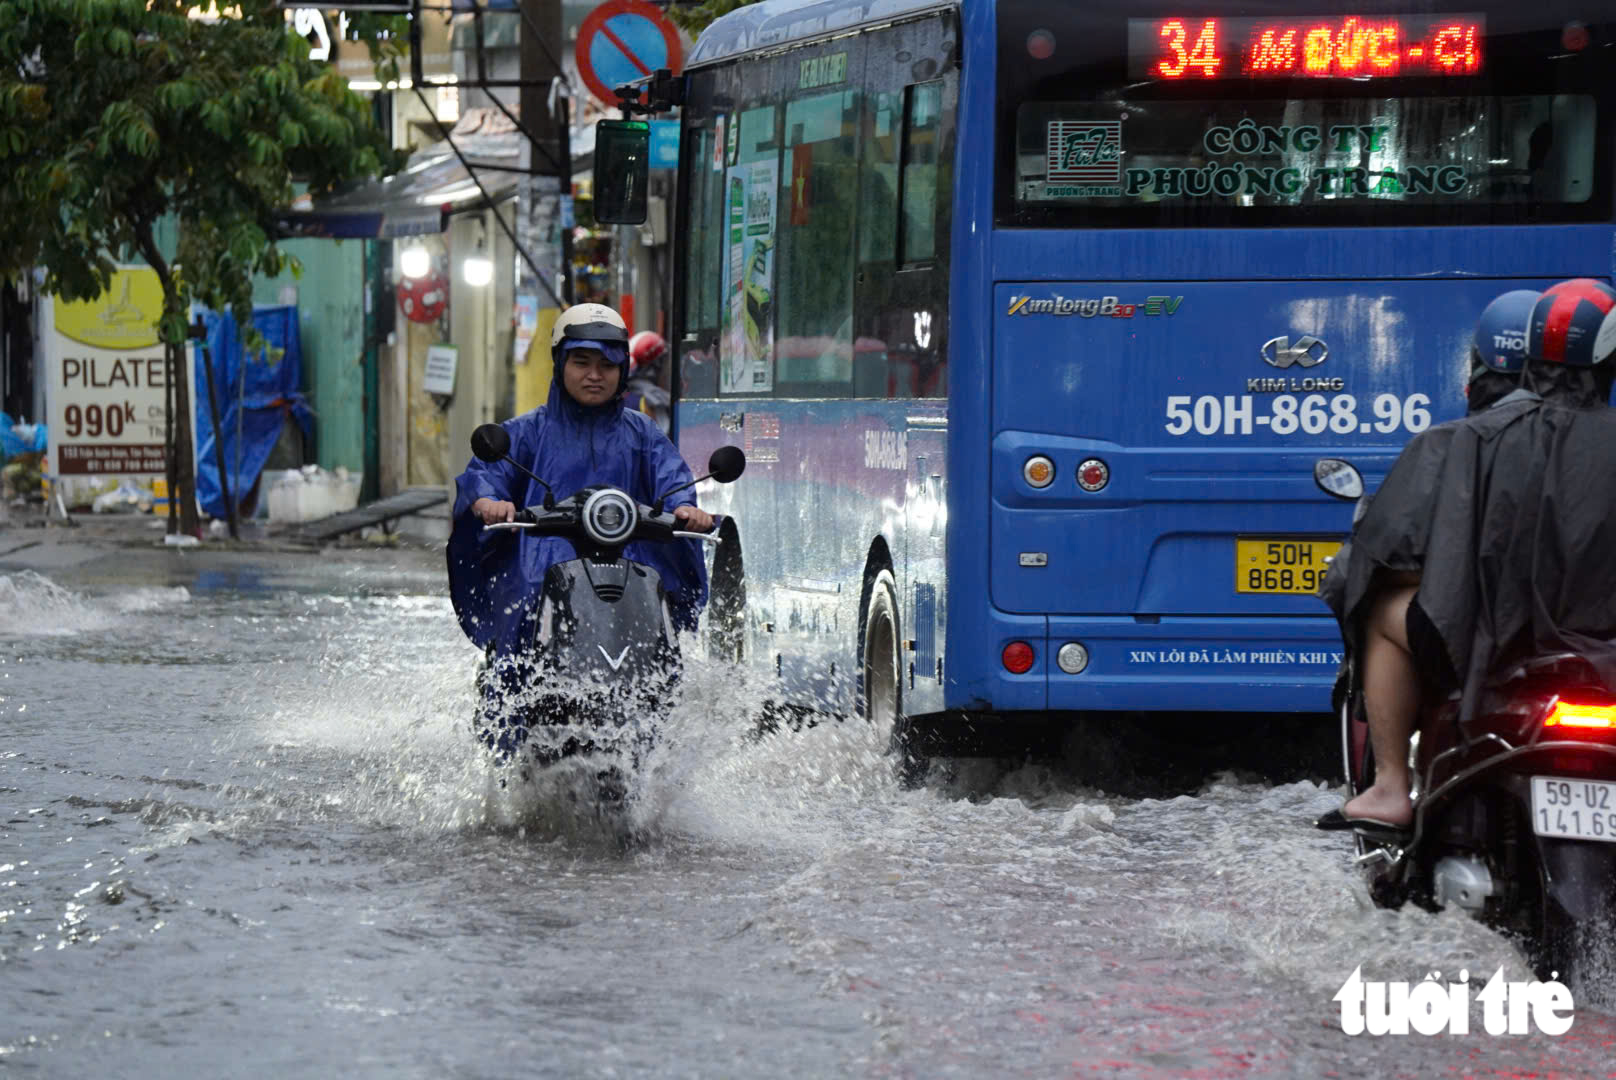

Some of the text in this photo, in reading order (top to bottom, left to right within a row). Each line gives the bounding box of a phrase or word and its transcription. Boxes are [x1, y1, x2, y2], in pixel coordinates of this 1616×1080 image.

[1159, 21, 1220, 75] 34
[1204, 118, 1389, 154] CÔNG TY
[1086, 186, 1120, 197] TRANG
[1126, 161, 1468, 197] PHƯƠNG TRANG
[1493, 335, 1525, 350] THO
[1247, 377, 1345, 392] KIM LONG
[1165, 393, 1432, 435] 50H-868.96
[1267, 543, 1312, 565] 50H
[1130, 651, 1156, 663] XIN
[1189, 649, 1210, 663] ĐÃ
[1299, 652, 1327, 664] KHI
[1331, 652, 1345, 664] X
[1546, 781, 1610, 809] 59-U2
